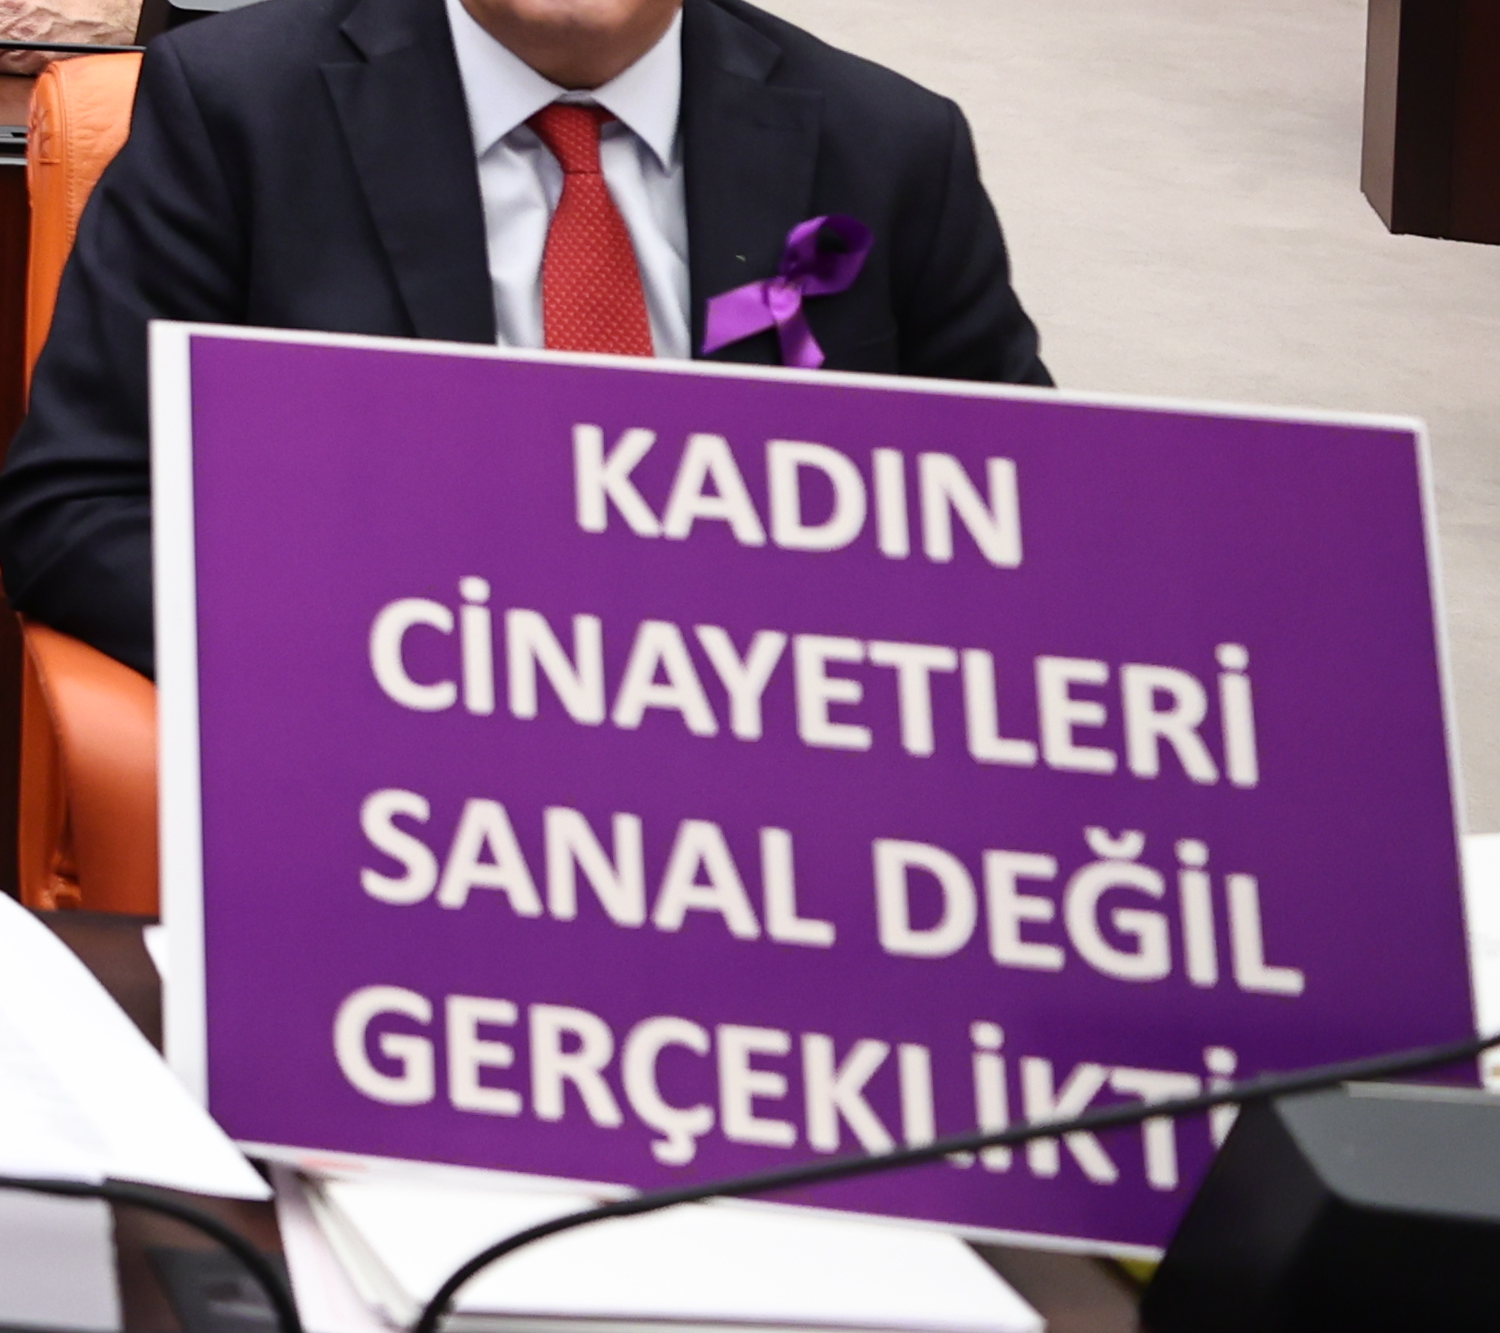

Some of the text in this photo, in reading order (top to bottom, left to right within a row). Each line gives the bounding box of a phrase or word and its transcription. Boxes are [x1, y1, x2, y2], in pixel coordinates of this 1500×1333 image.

[570, 422, 1024, 568] KADIN
[368, 576, 1259, 788] CİNAYETLERİ
[359, 789, 1304, 995] SANAL DEĞİL
[332, 984, 1241, 1192] GERÇEKLİKTİ
